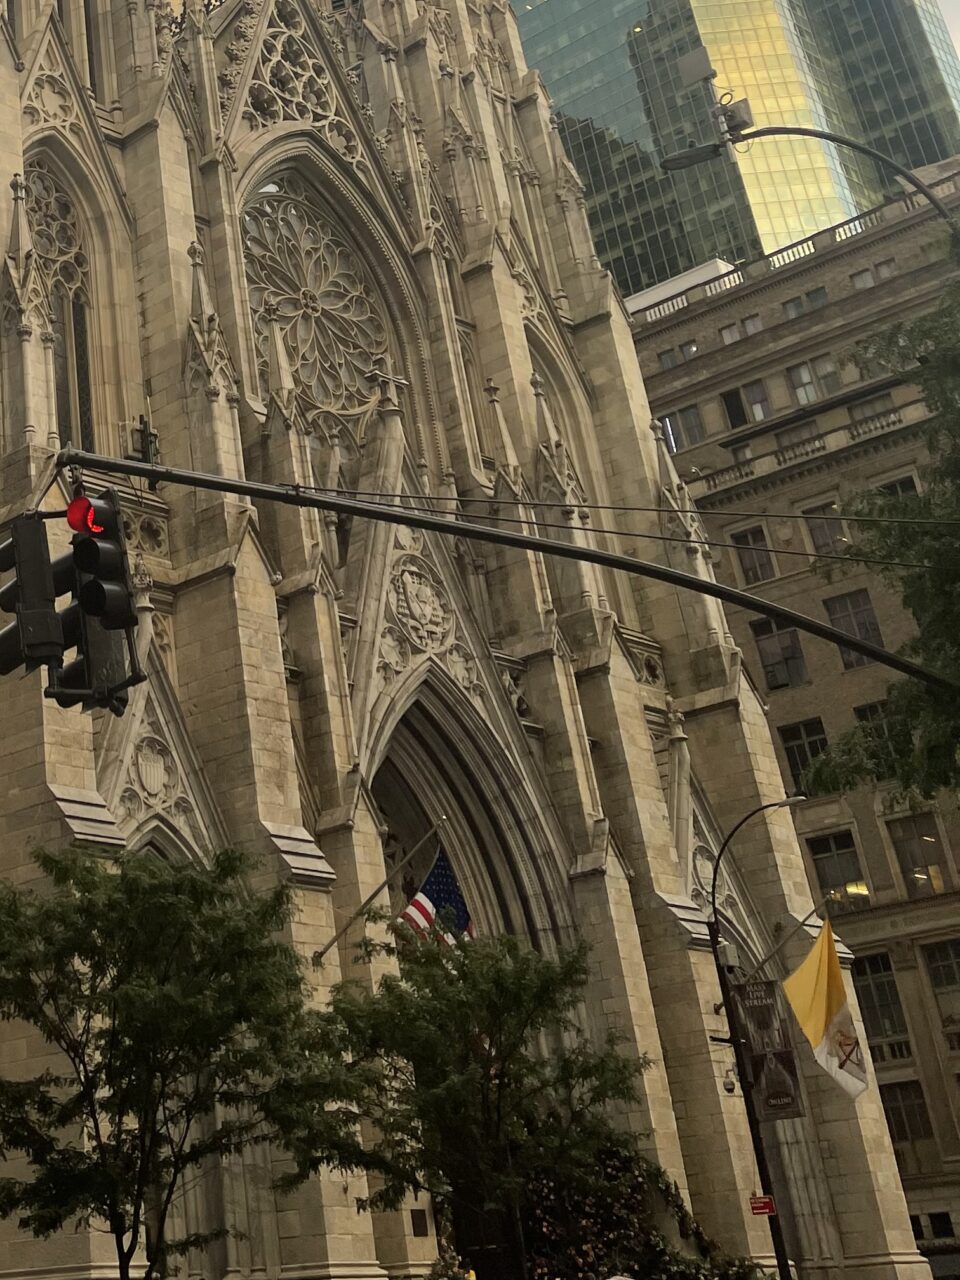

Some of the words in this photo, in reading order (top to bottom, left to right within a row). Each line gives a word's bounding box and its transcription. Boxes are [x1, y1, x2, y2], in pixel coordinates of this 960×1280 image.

[746, 983, 766, 992] MASS
[749, 991, 765, 999] LIVE
[744, 998, 774, 1007] STREAM
